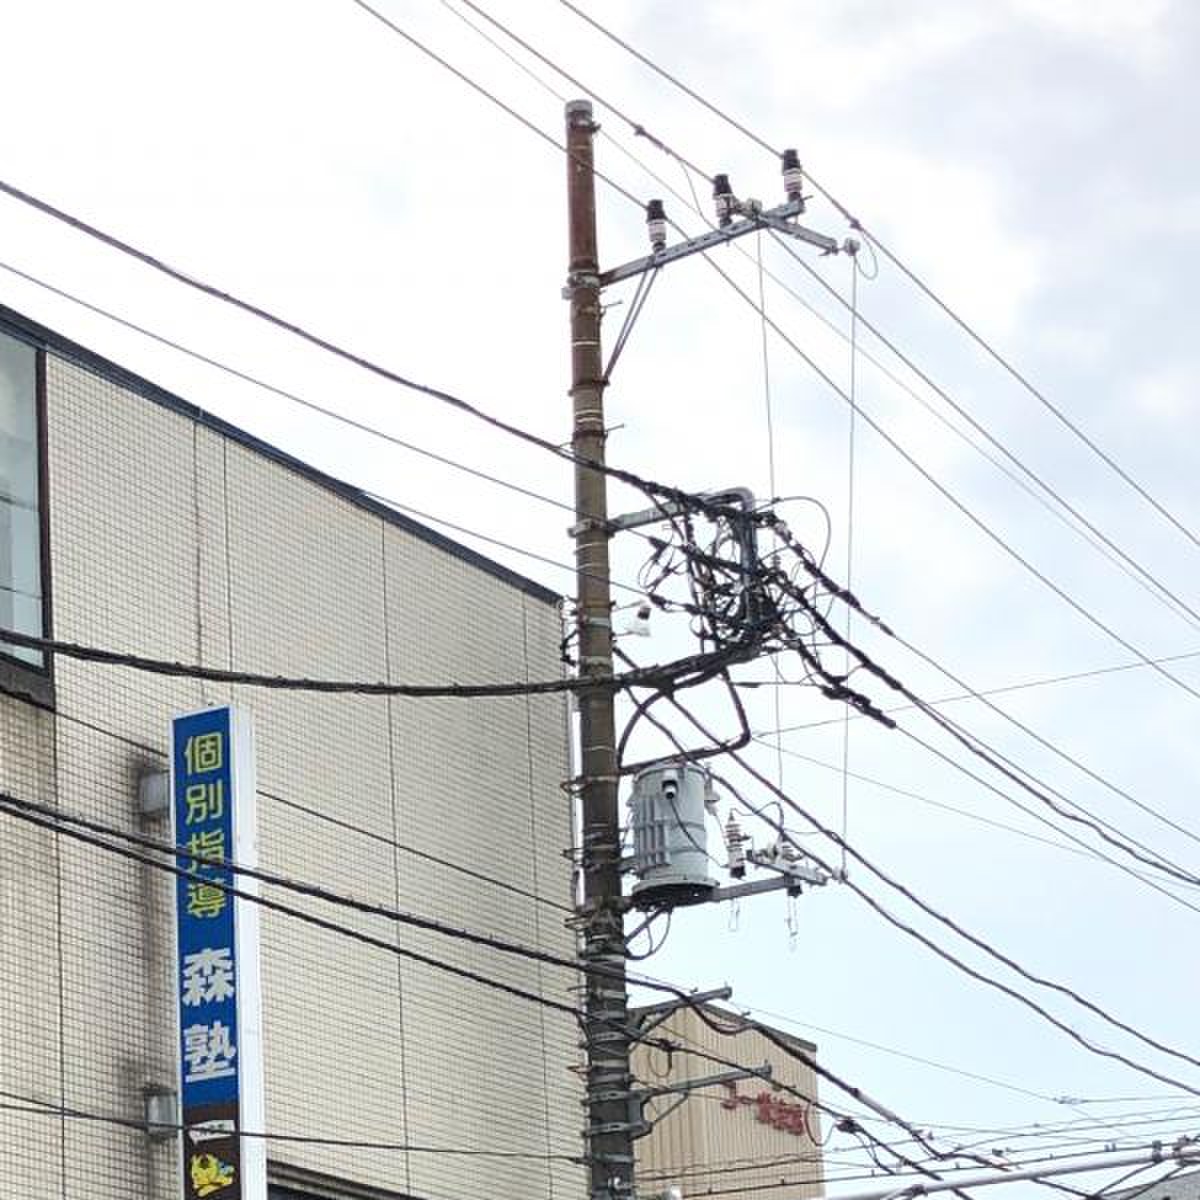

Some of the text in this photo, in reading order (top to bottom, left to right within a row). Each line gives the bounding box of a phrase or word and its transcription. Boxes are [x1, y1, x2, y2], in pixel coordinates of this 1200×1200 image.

[184, 731, 227, 919] 個別指導
[183, 946, 236, 1083] 森塾
